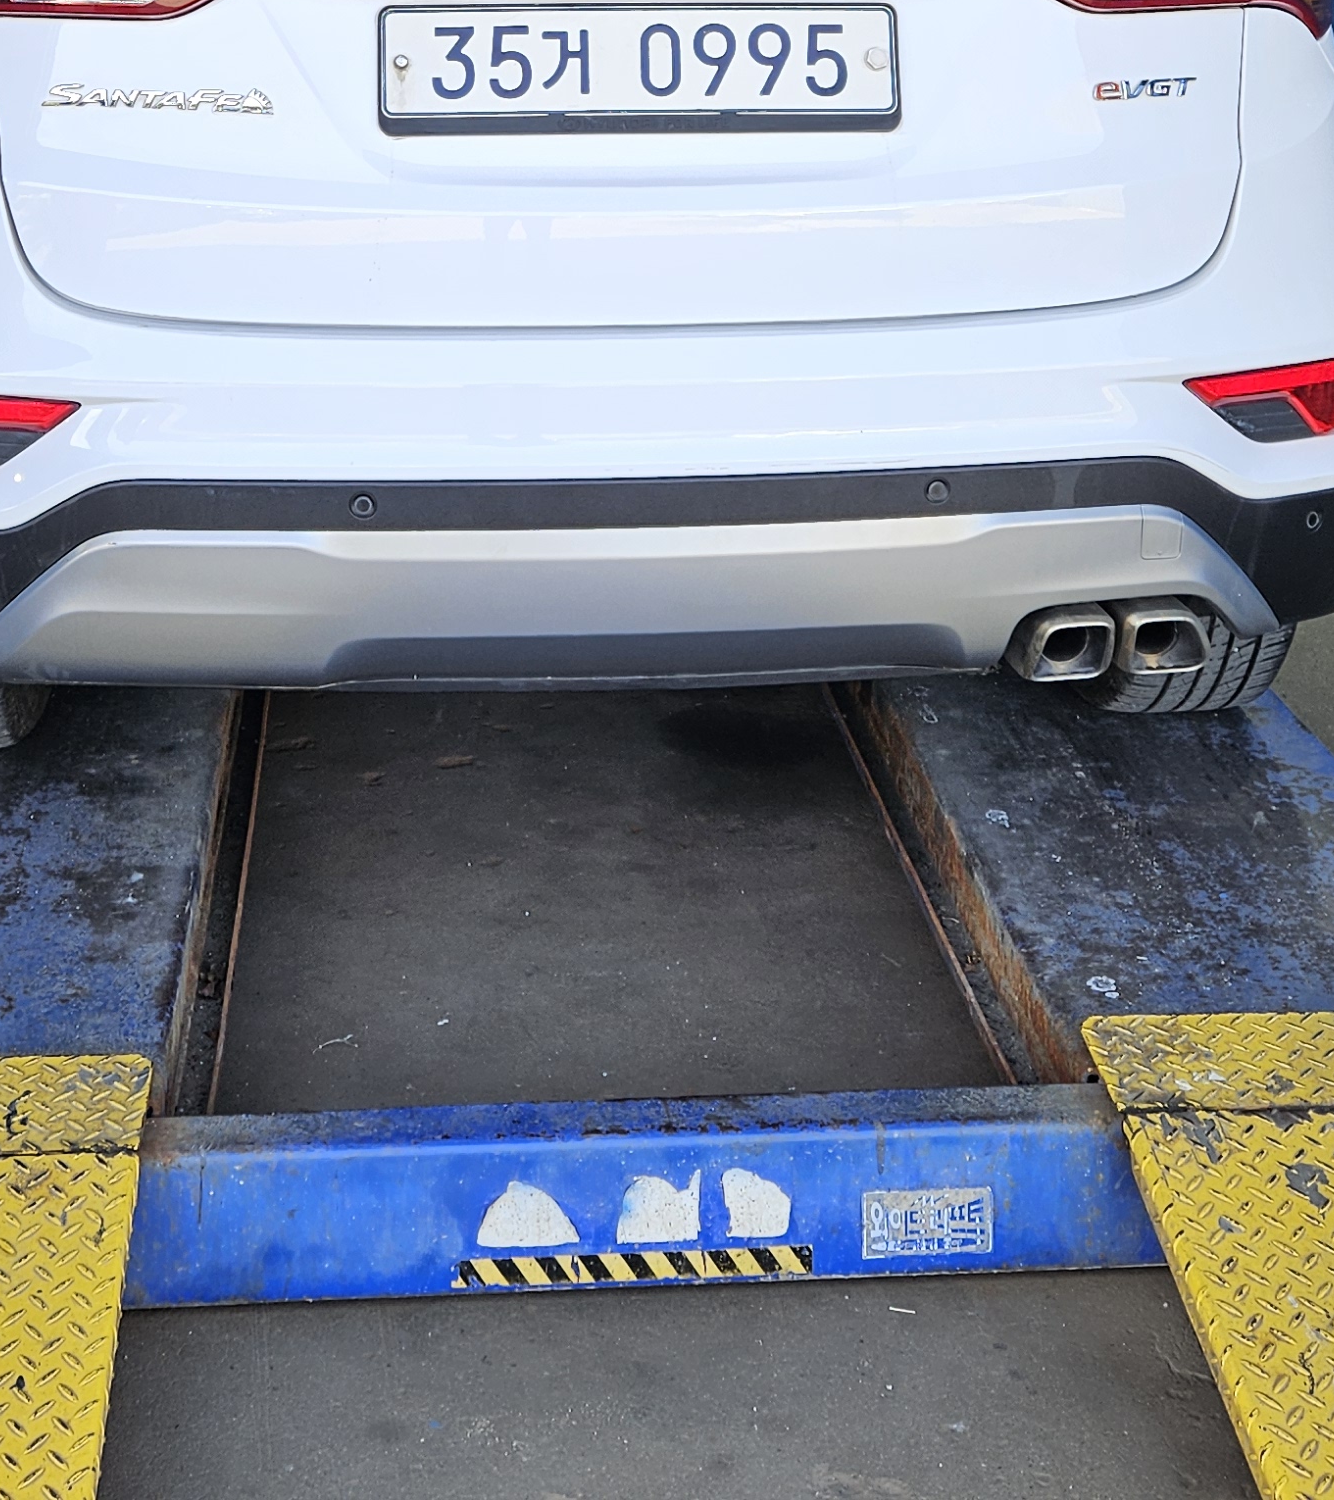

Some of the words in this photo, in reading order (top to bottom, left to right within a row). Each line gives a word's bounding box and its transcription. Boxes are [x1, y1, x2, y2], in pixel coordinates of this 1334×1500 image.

[431, 24, 591, 100] 35거
[638, 22, 849, 98] 0995
[1092, 77, 1198, 101] eVGT
